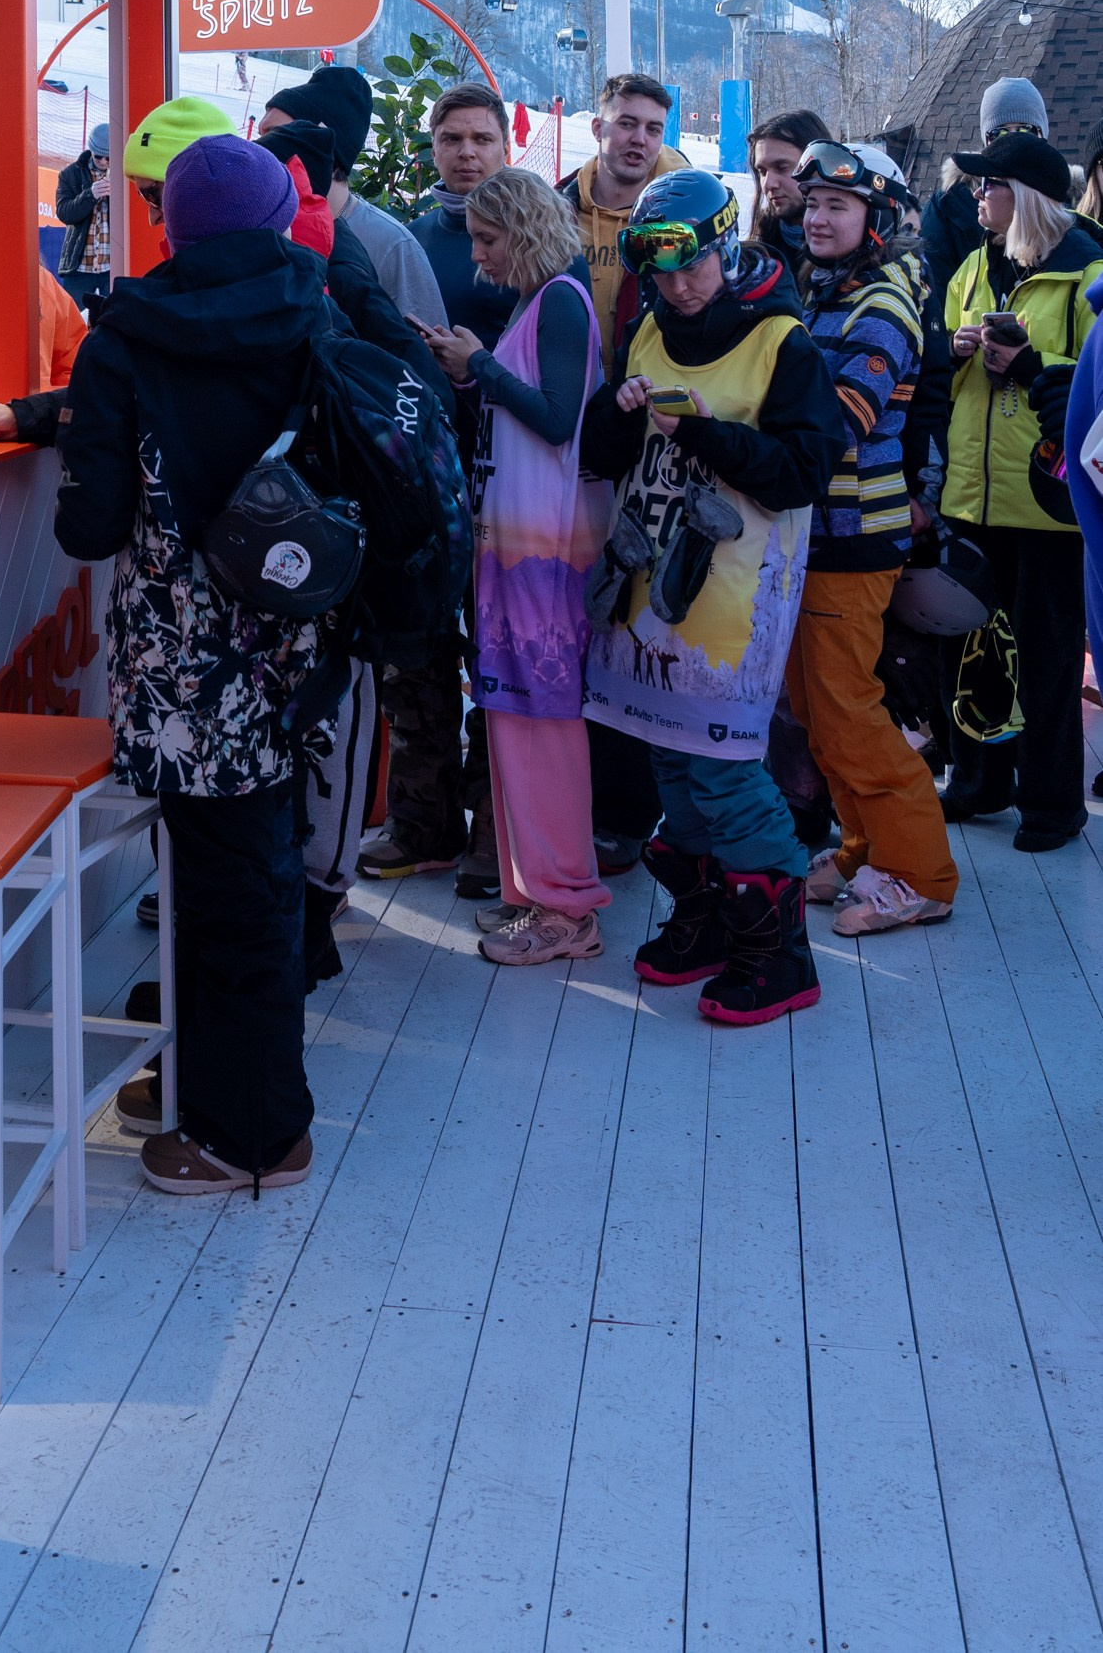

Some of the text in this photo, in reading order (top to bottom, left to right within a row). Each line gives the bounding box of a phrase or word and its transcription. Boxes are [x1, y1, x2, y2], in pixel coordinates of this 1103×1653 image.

[38, 201, 53, 219] ОЗА
[501, 683, 531, 698] БАНК
[632, 707, 684, 731] Avito Team
[731, 730, 760, 740] БАНК
